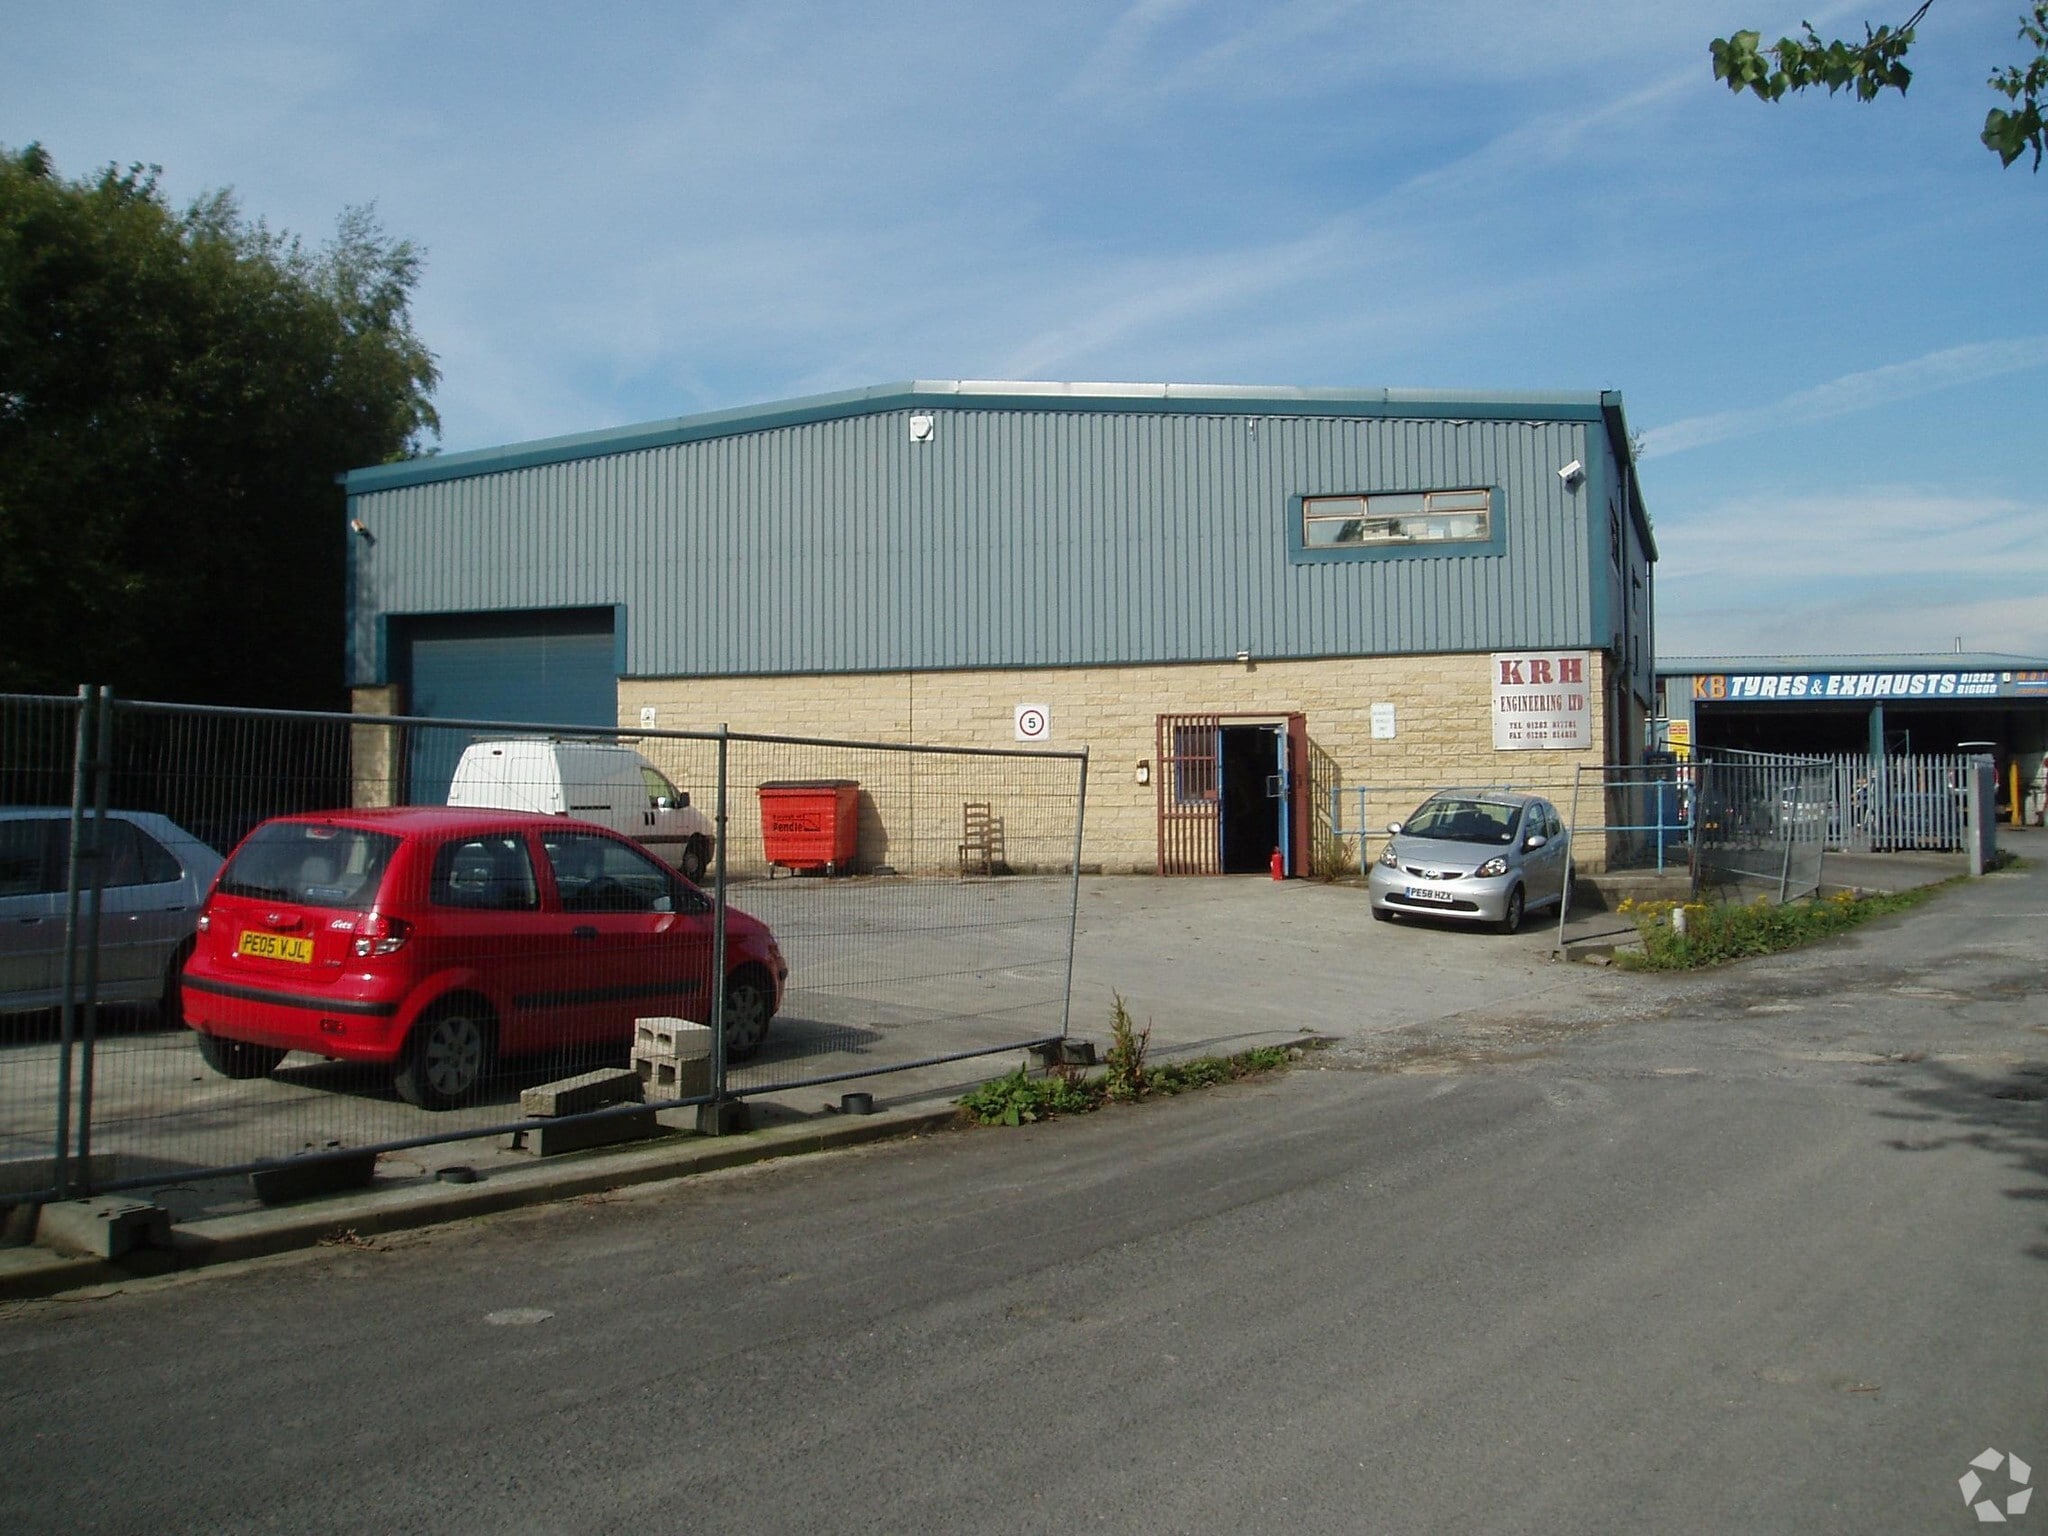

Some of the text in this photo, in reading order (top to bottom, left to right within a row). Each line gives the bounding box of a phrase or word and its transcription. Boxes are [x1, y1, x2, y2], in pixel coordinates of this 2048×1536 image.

[1500, 658, 1583, 685] KRH
[1692, 674, 1957, 698] KB TYRES & EXHAUSTS
[1500, 694, 1584, 712] ENGINEERING LTD
[1028, 717, 1036, 728] 5
[1509, 721, 1522, 729] TEL
[1411, 887, 1452, 900] PE58 HZX
[243, 934, 305, 958] PE05 VJL
